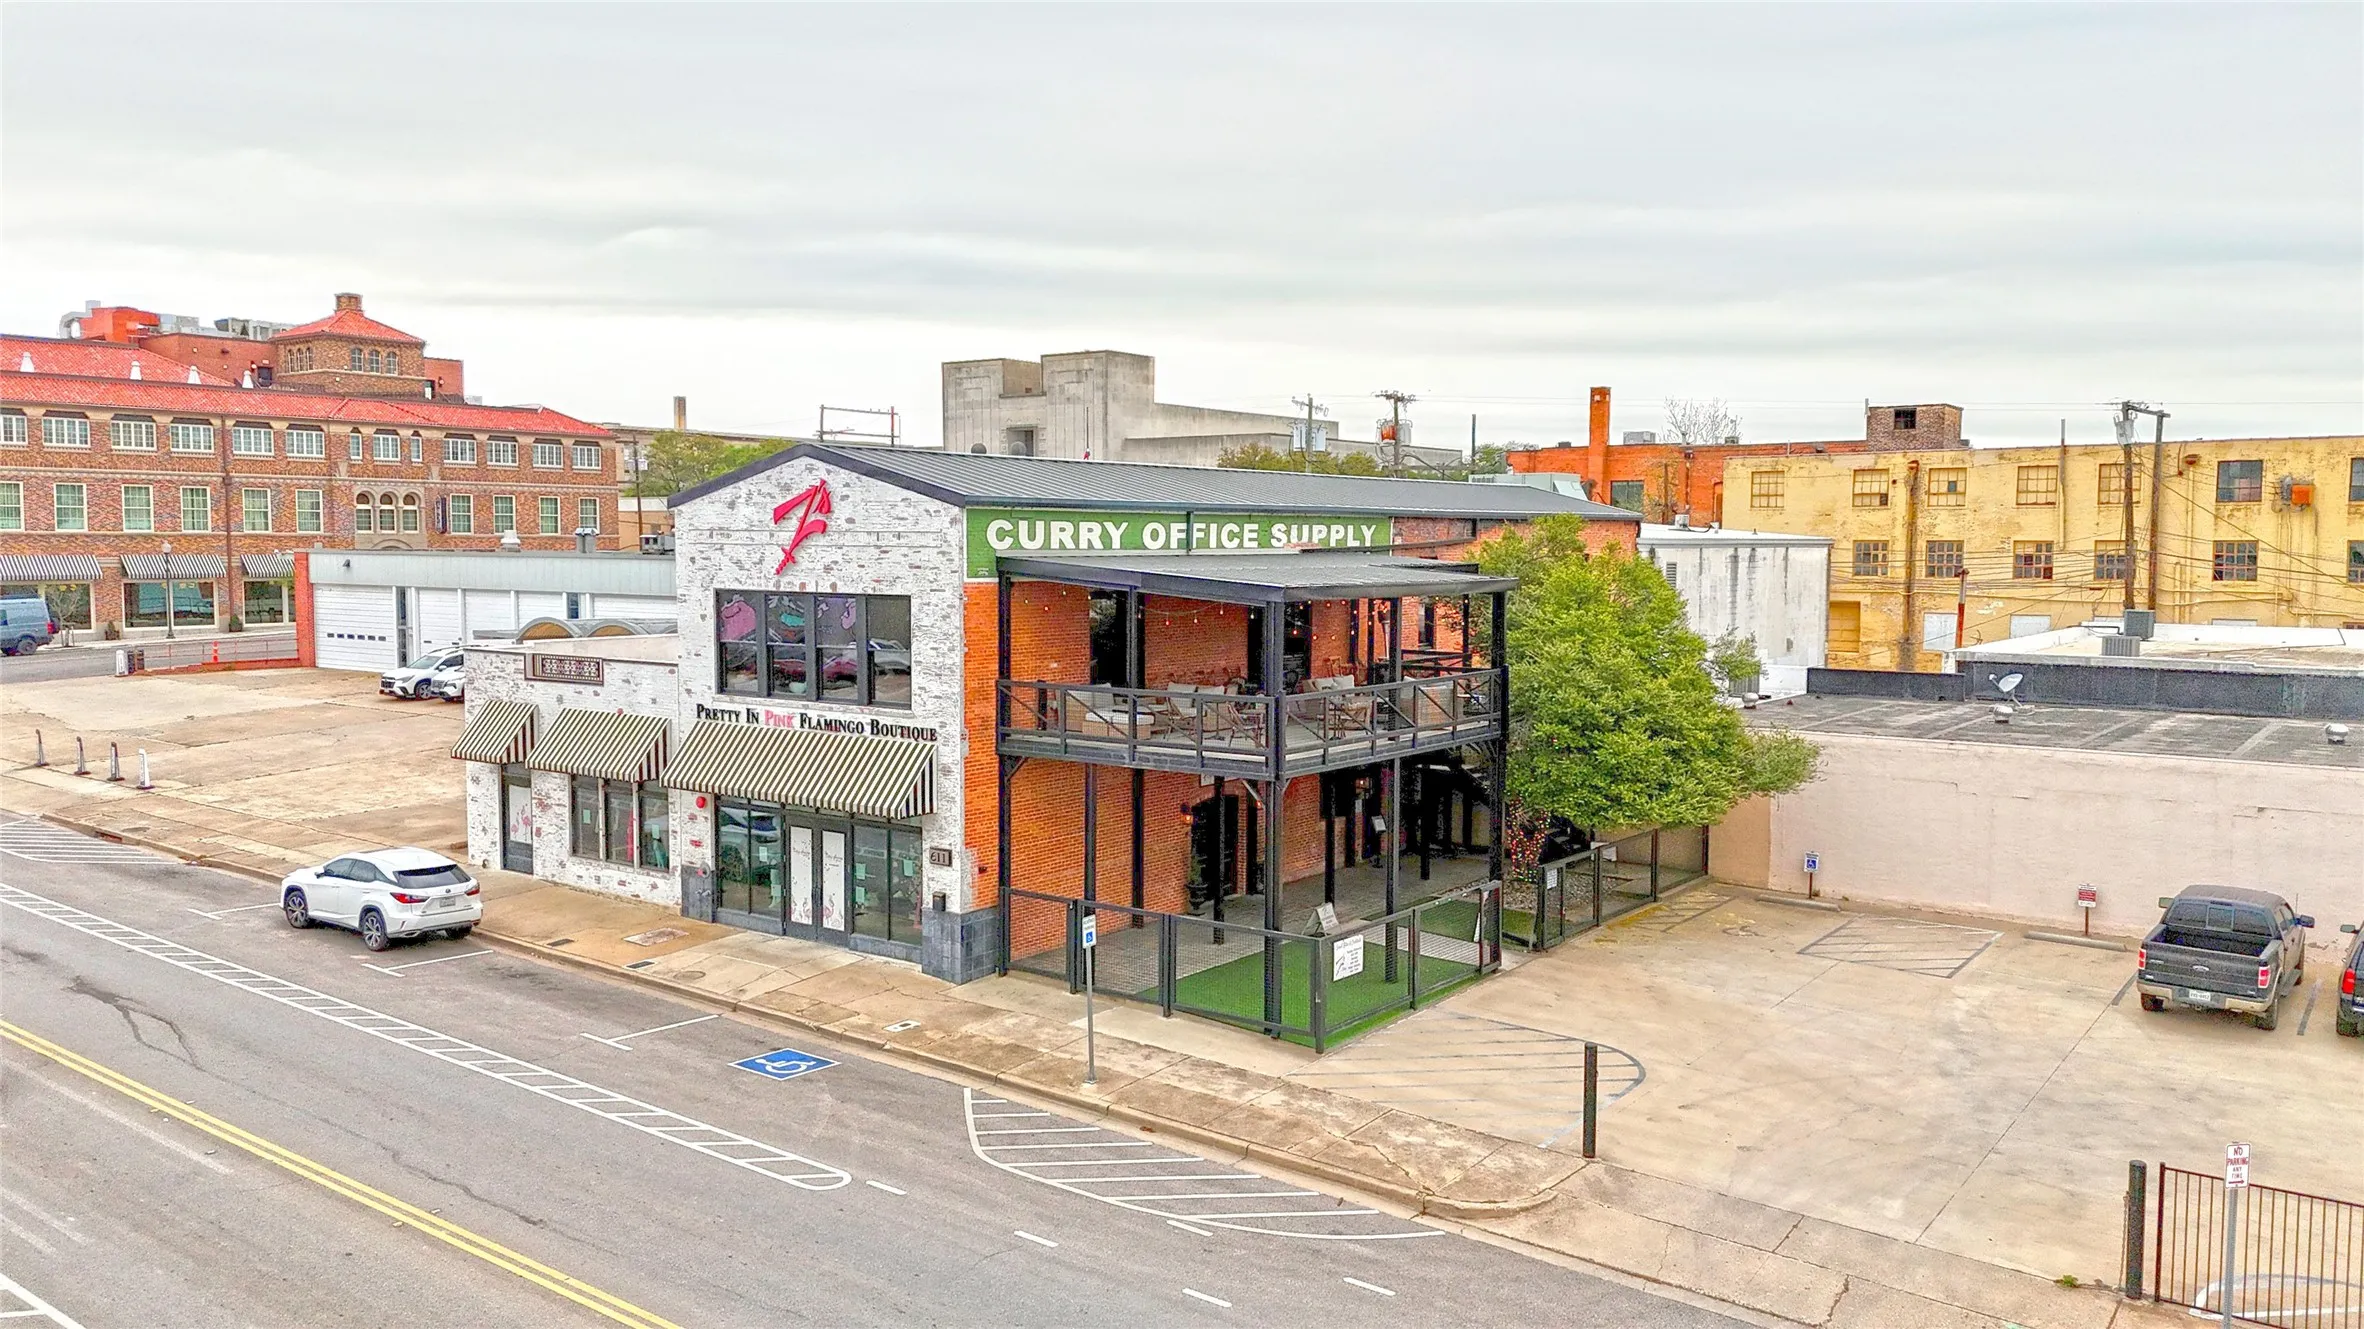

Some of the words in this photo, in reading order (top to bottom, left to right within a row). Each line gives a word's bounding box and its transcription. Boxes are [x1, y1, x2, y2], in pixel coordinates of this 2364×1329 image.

[986, 519, 1128, 550] CURRY
[1142, 522, 1259, 550] OFFICE
[1270, 523, 1377, 548] SUPPLY
[696, 703, 740, 722] PRETTY
[746, 707, 760, 725] IN
[764, 709, 795, 729] PINK
[799, 712, 866, 735] FLAMINGO
[870, 718, 938, 742] BOUTIQUE
[930, 851, 946, 863] 611
[2233, 1146, 2244, 1156] NO
